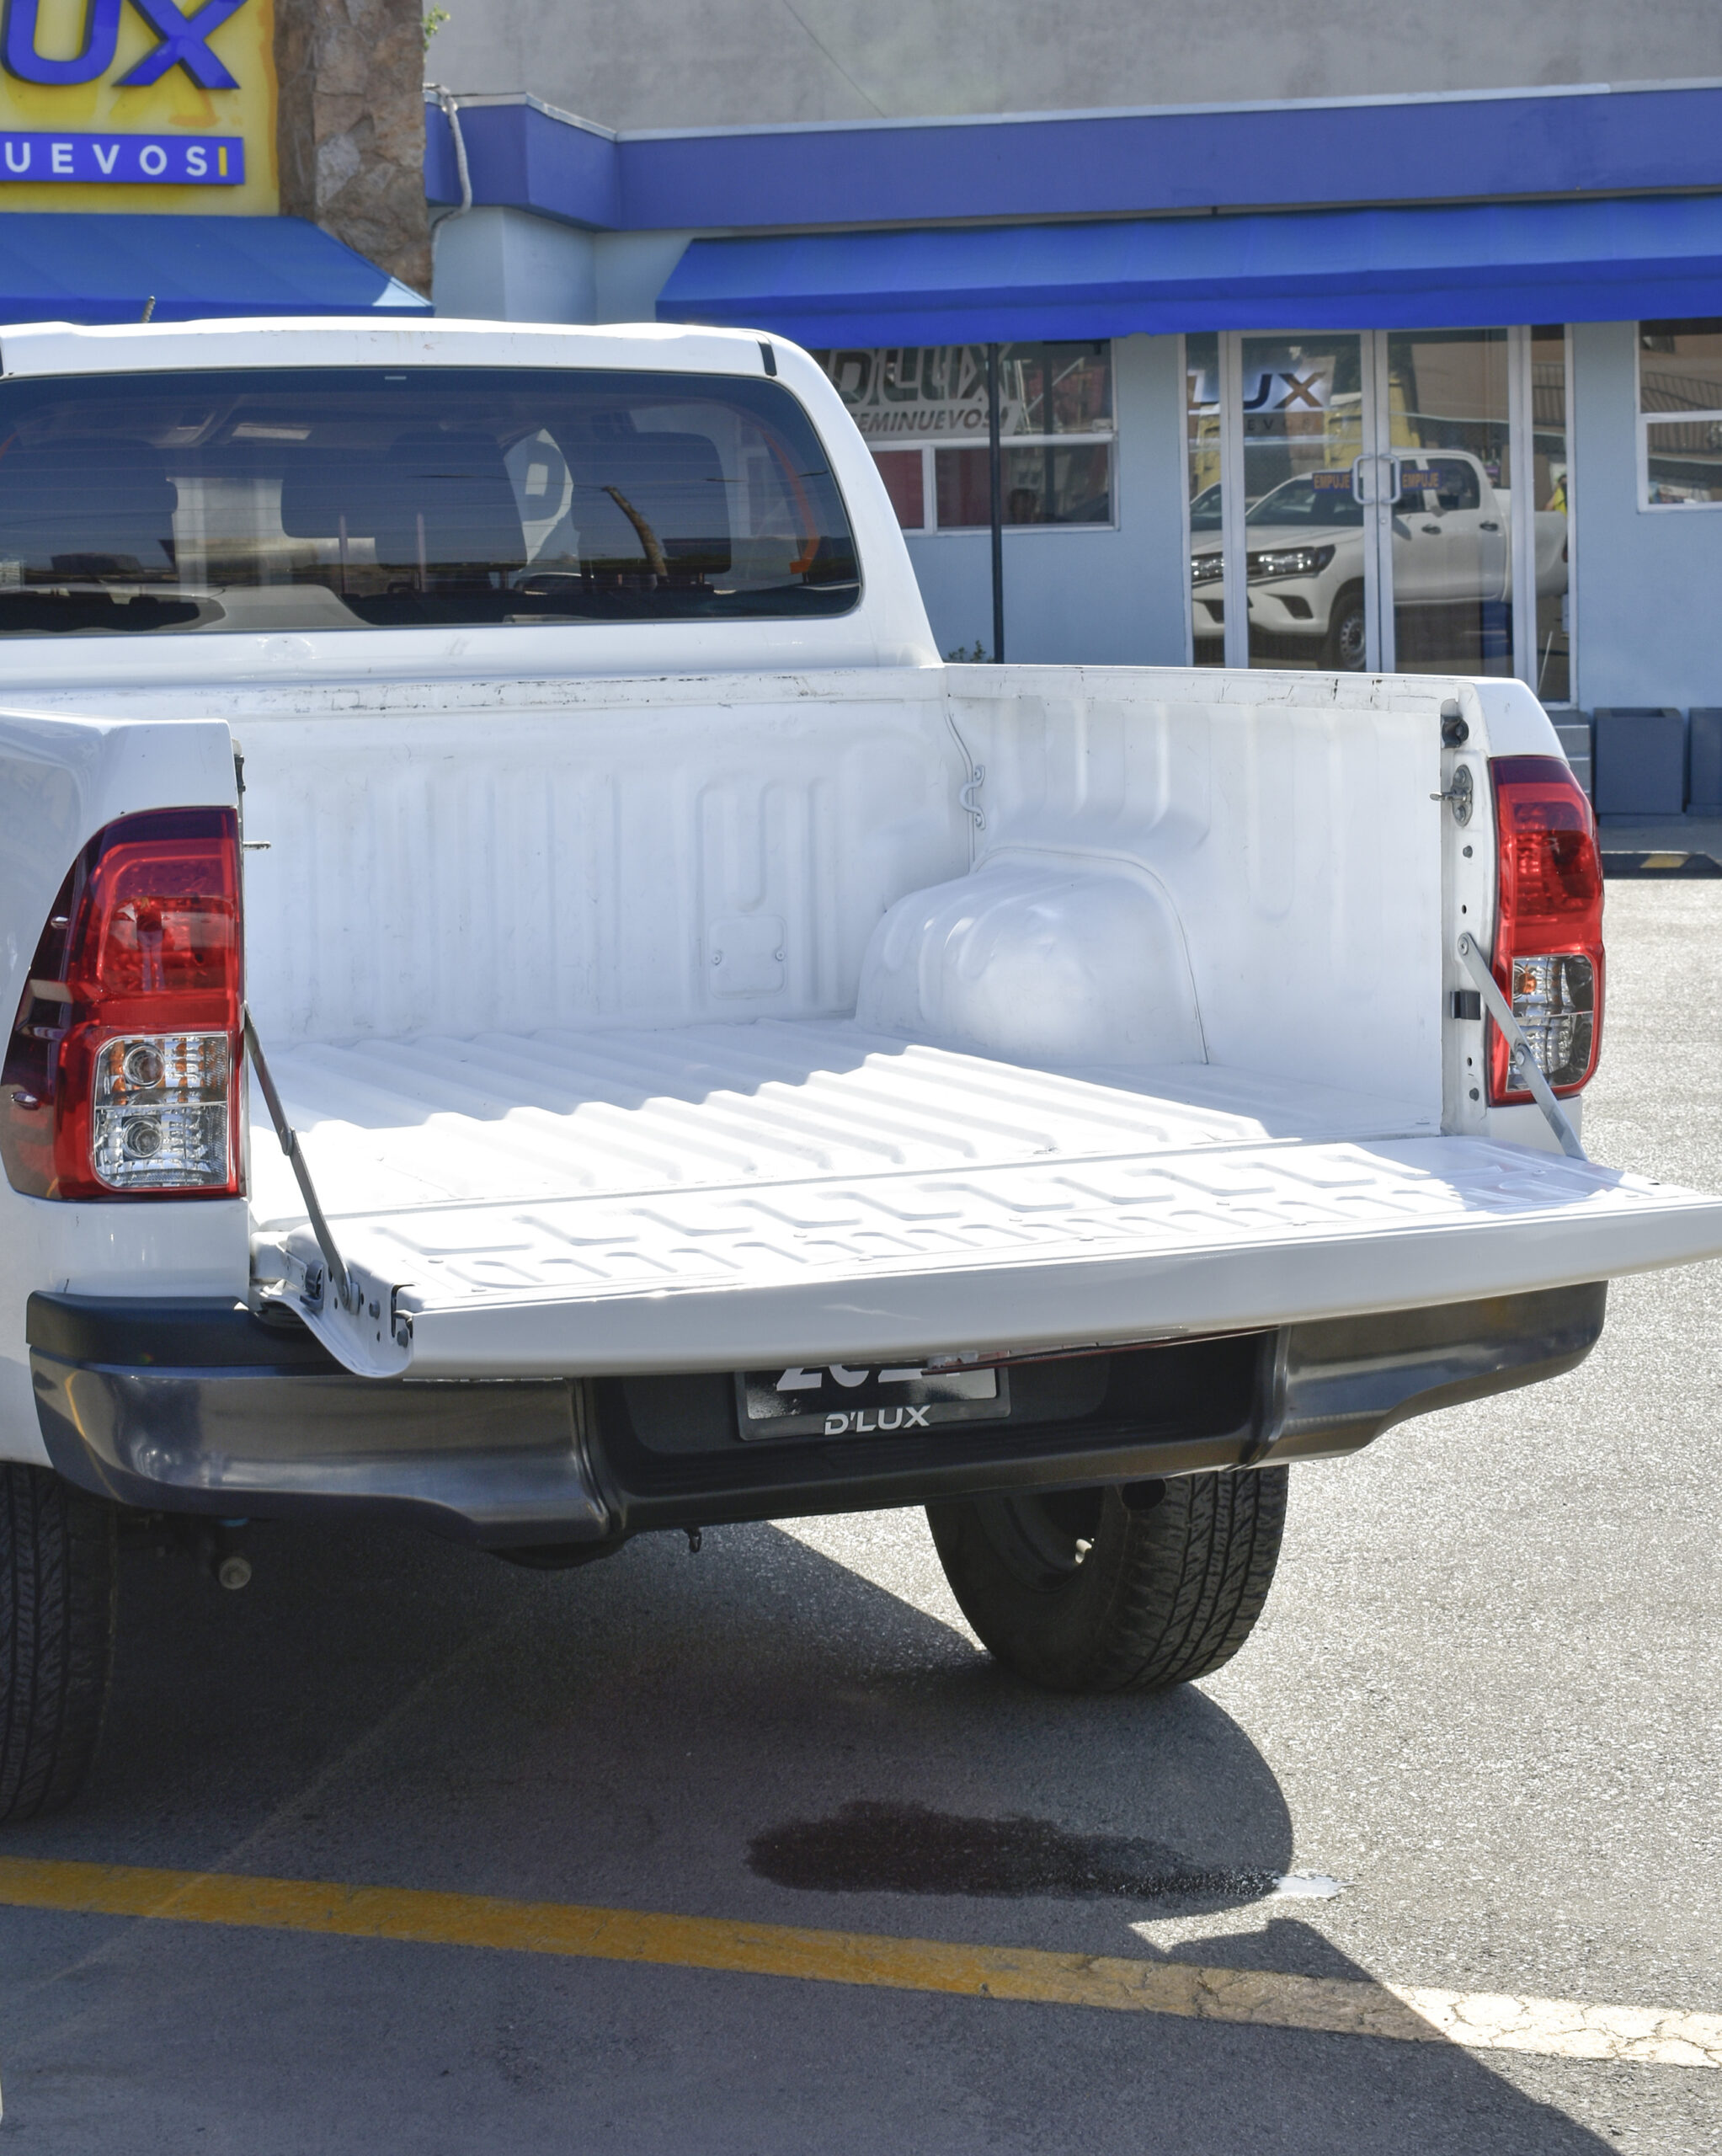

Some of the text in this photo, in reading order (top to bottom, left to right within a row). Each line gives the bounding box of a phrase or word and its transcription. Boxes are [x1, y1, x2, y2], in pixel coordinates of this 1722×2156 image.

[1314, 474, 1351, 489] EMPUJE
[1402, 472, 1439, 488] EMPUJE
[824, 1405, 931, 1435] D'LUX
